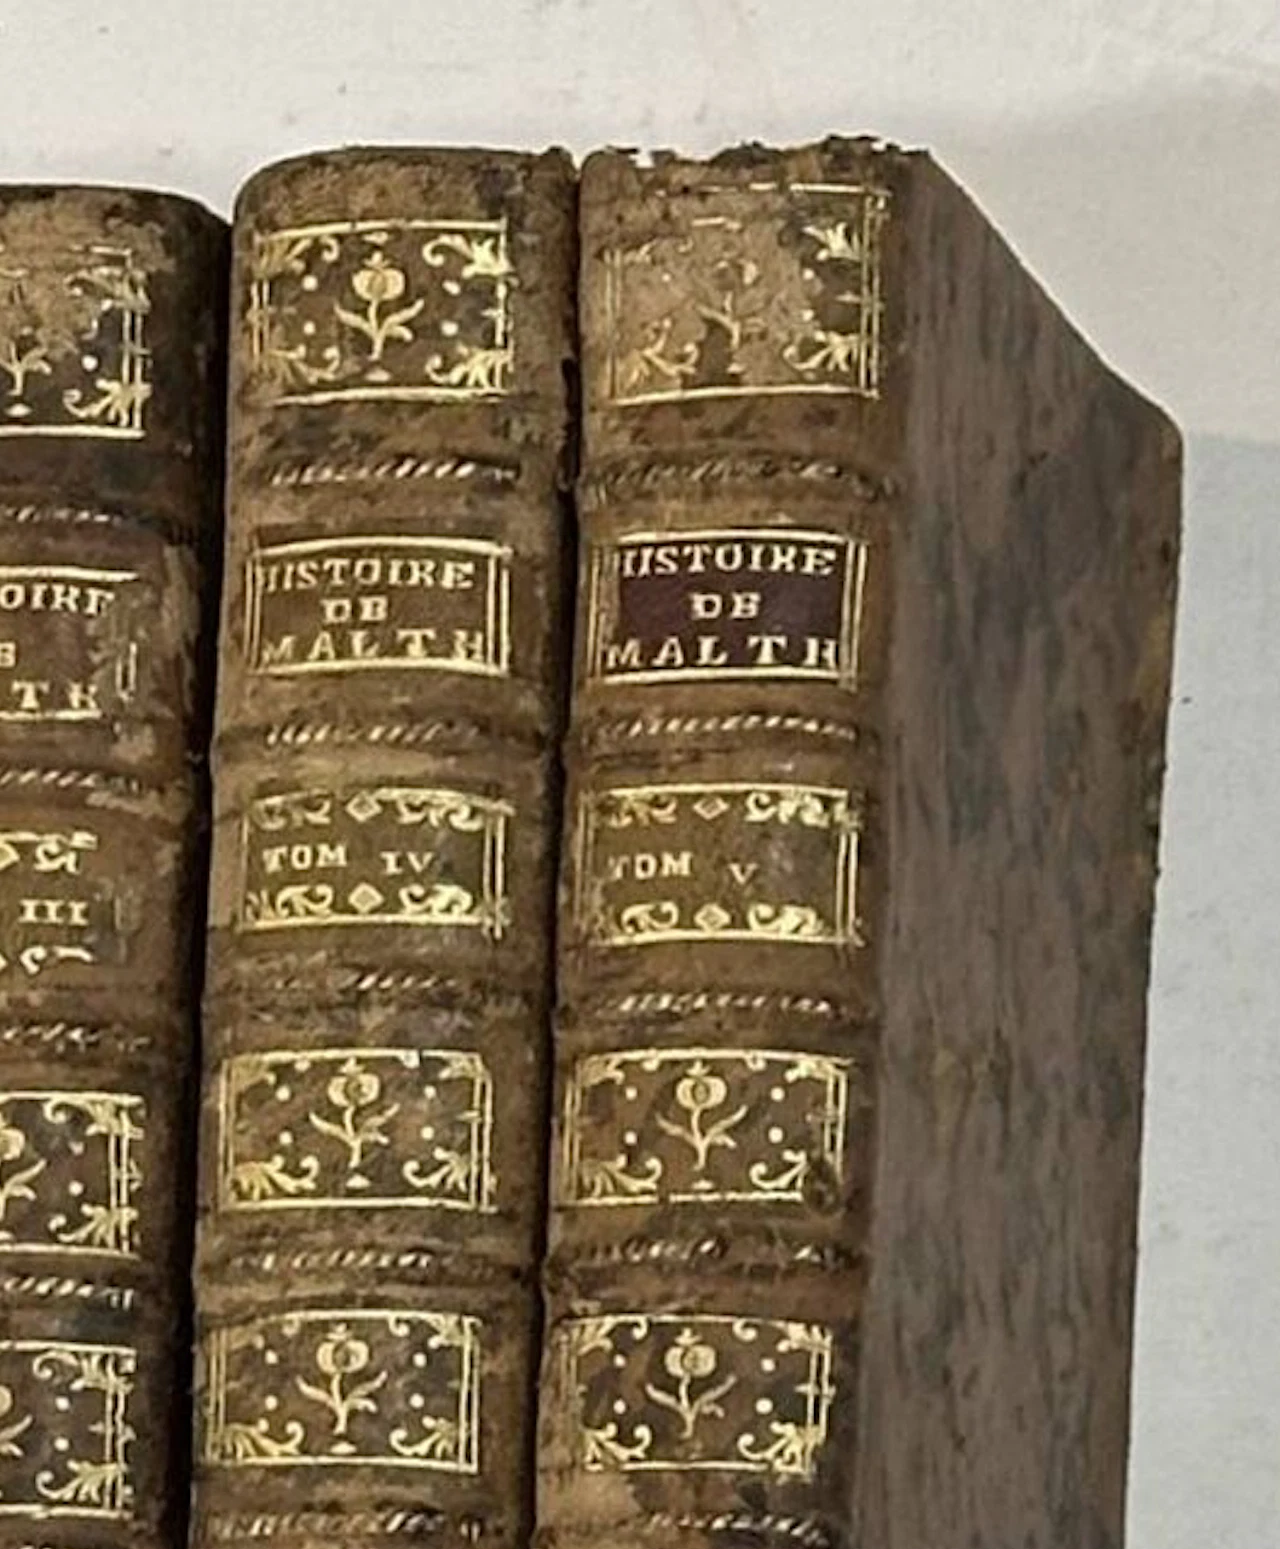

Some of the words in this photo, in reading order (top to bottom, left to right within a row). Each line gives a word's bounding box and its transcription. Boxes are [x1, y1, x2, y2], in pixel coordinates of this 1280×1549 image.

[322, 597, 387, 623] DE
[691, 593, 762, 620] DE
[262, 844, 348, 873] TOM
[381, 851, 435, 875] IV
[606, 852, 694, 880] TOM
[730, 862, 759, 885] V
[20, 899, 89, 926] III
